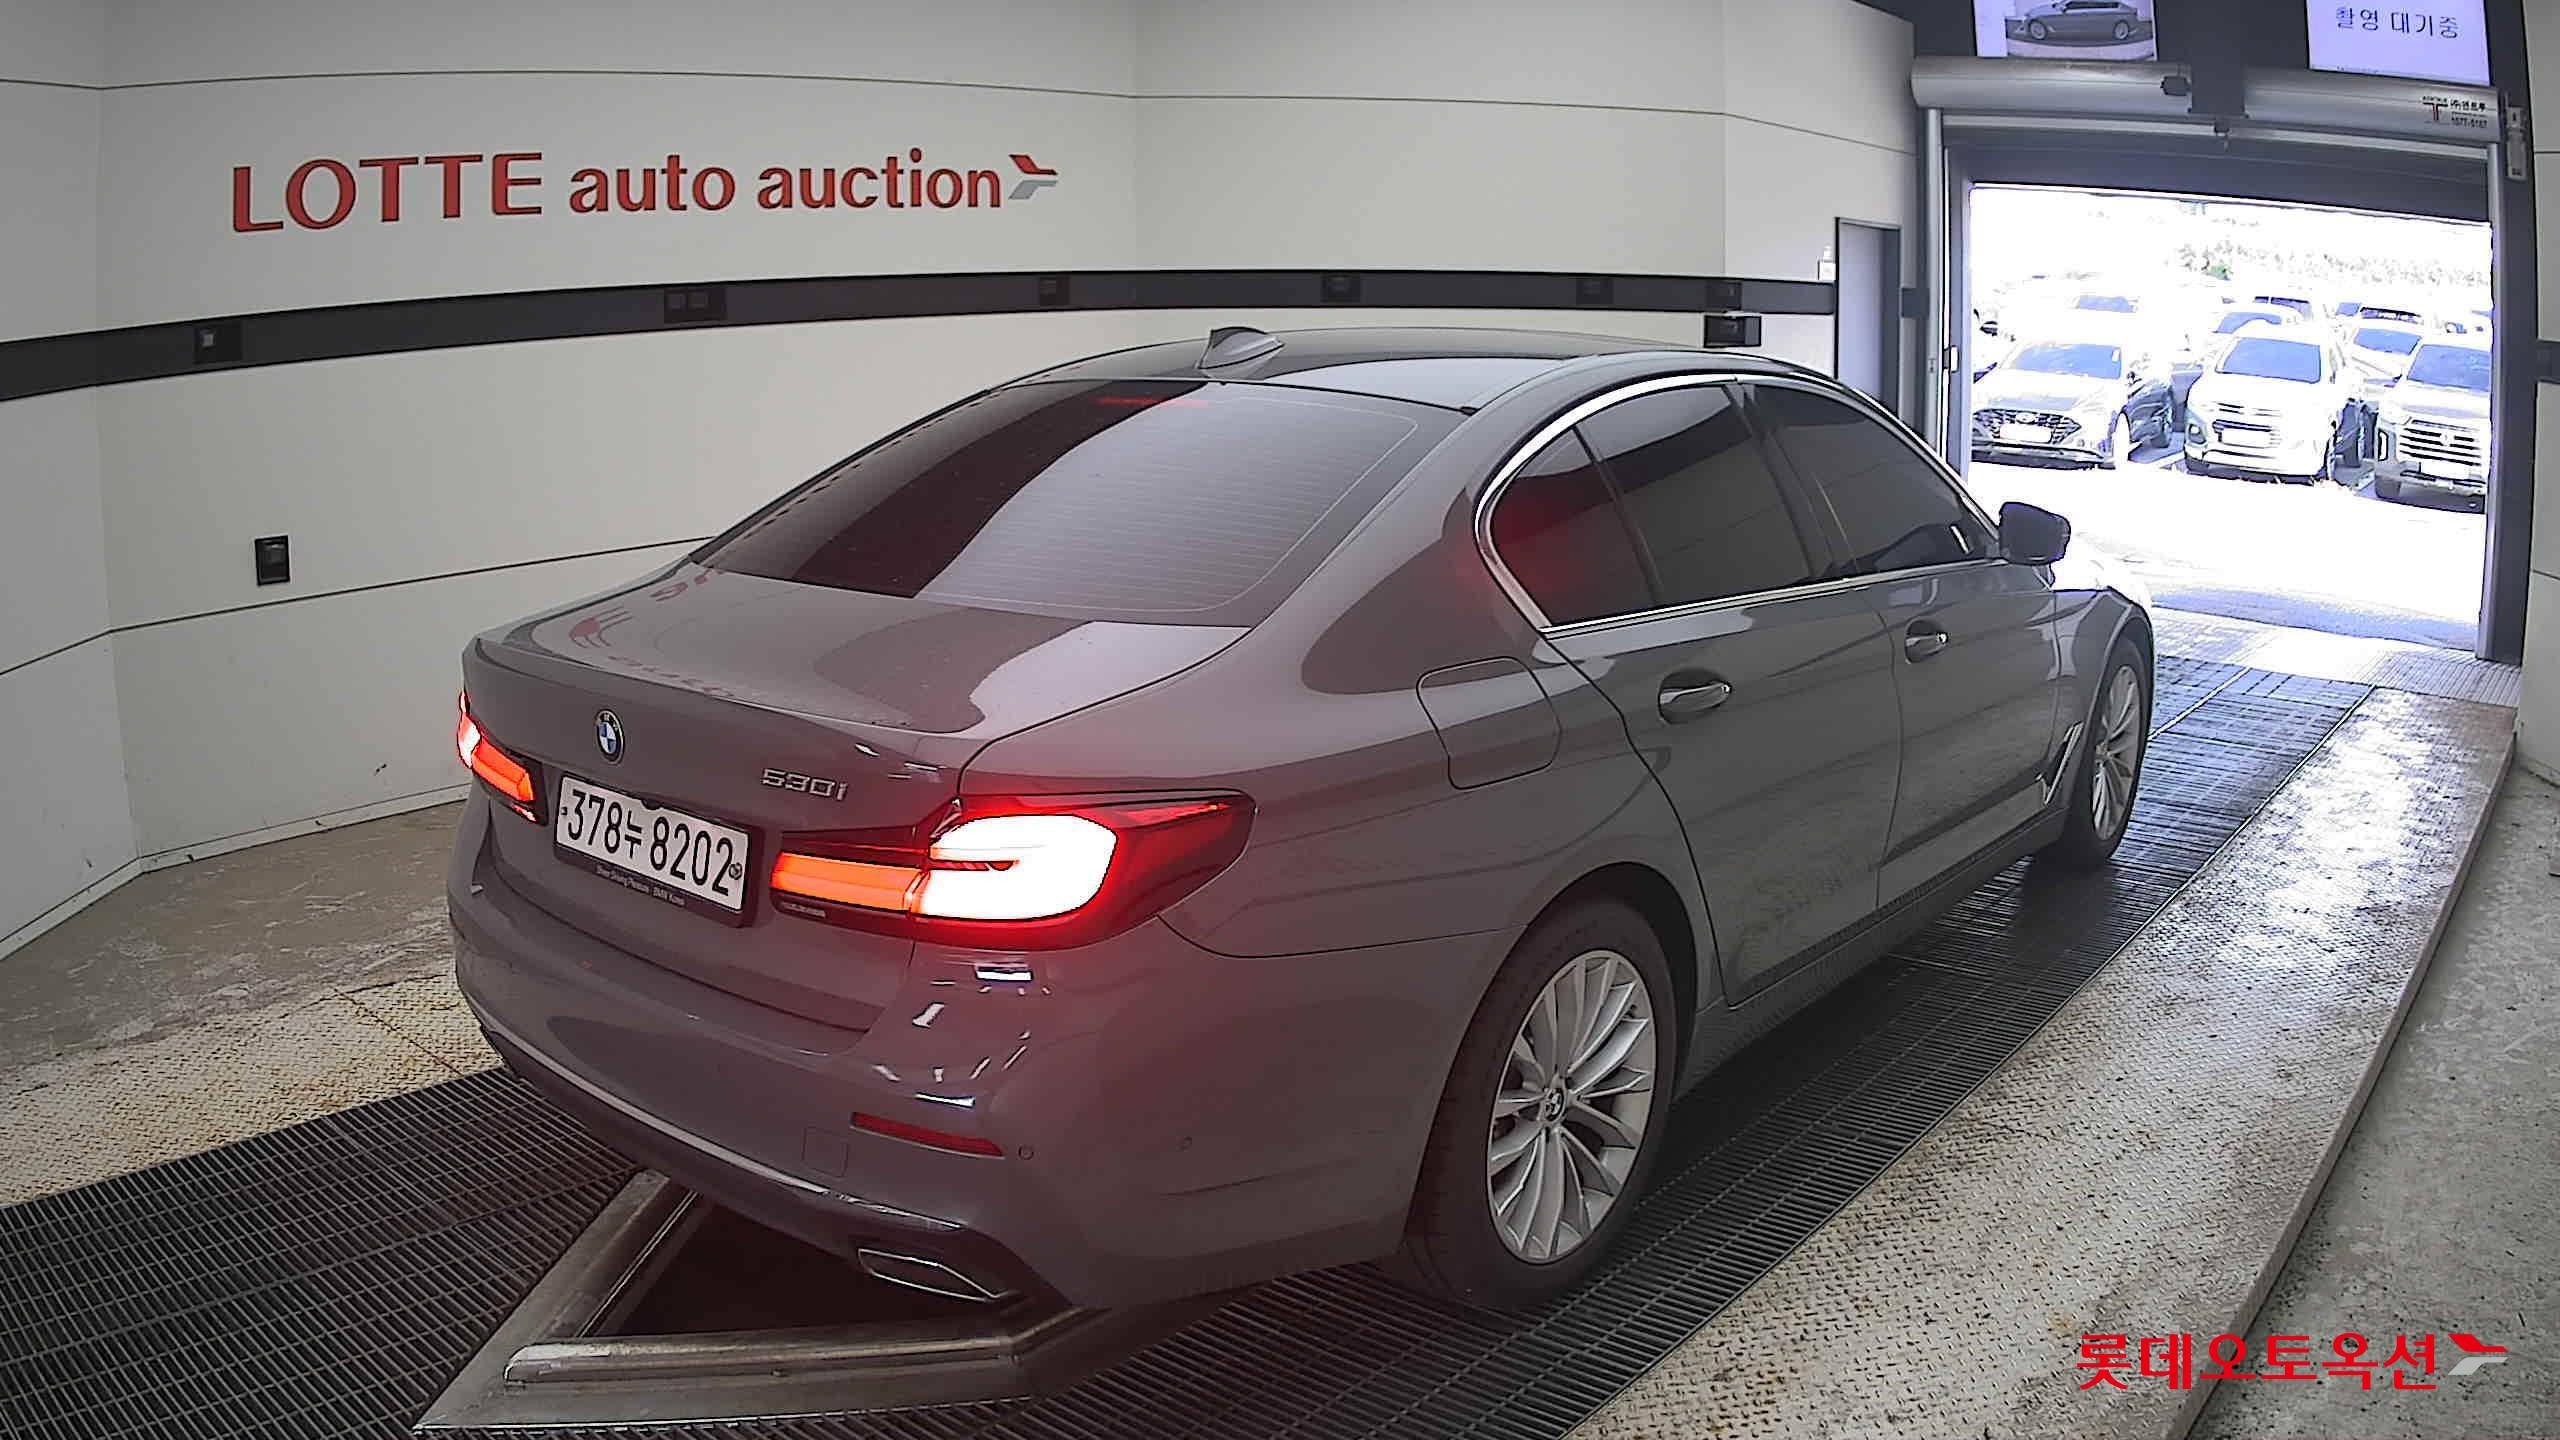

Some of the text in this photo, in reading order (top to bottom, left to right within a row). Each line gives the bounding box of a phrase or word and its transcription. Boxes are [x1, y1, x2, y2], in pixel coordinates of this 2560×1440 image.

[2391, 12, 2458, 39] 대기중
[232, 147, 1001, 233] LOTTE auto auction
[761, 767, 848, 801] 530i
